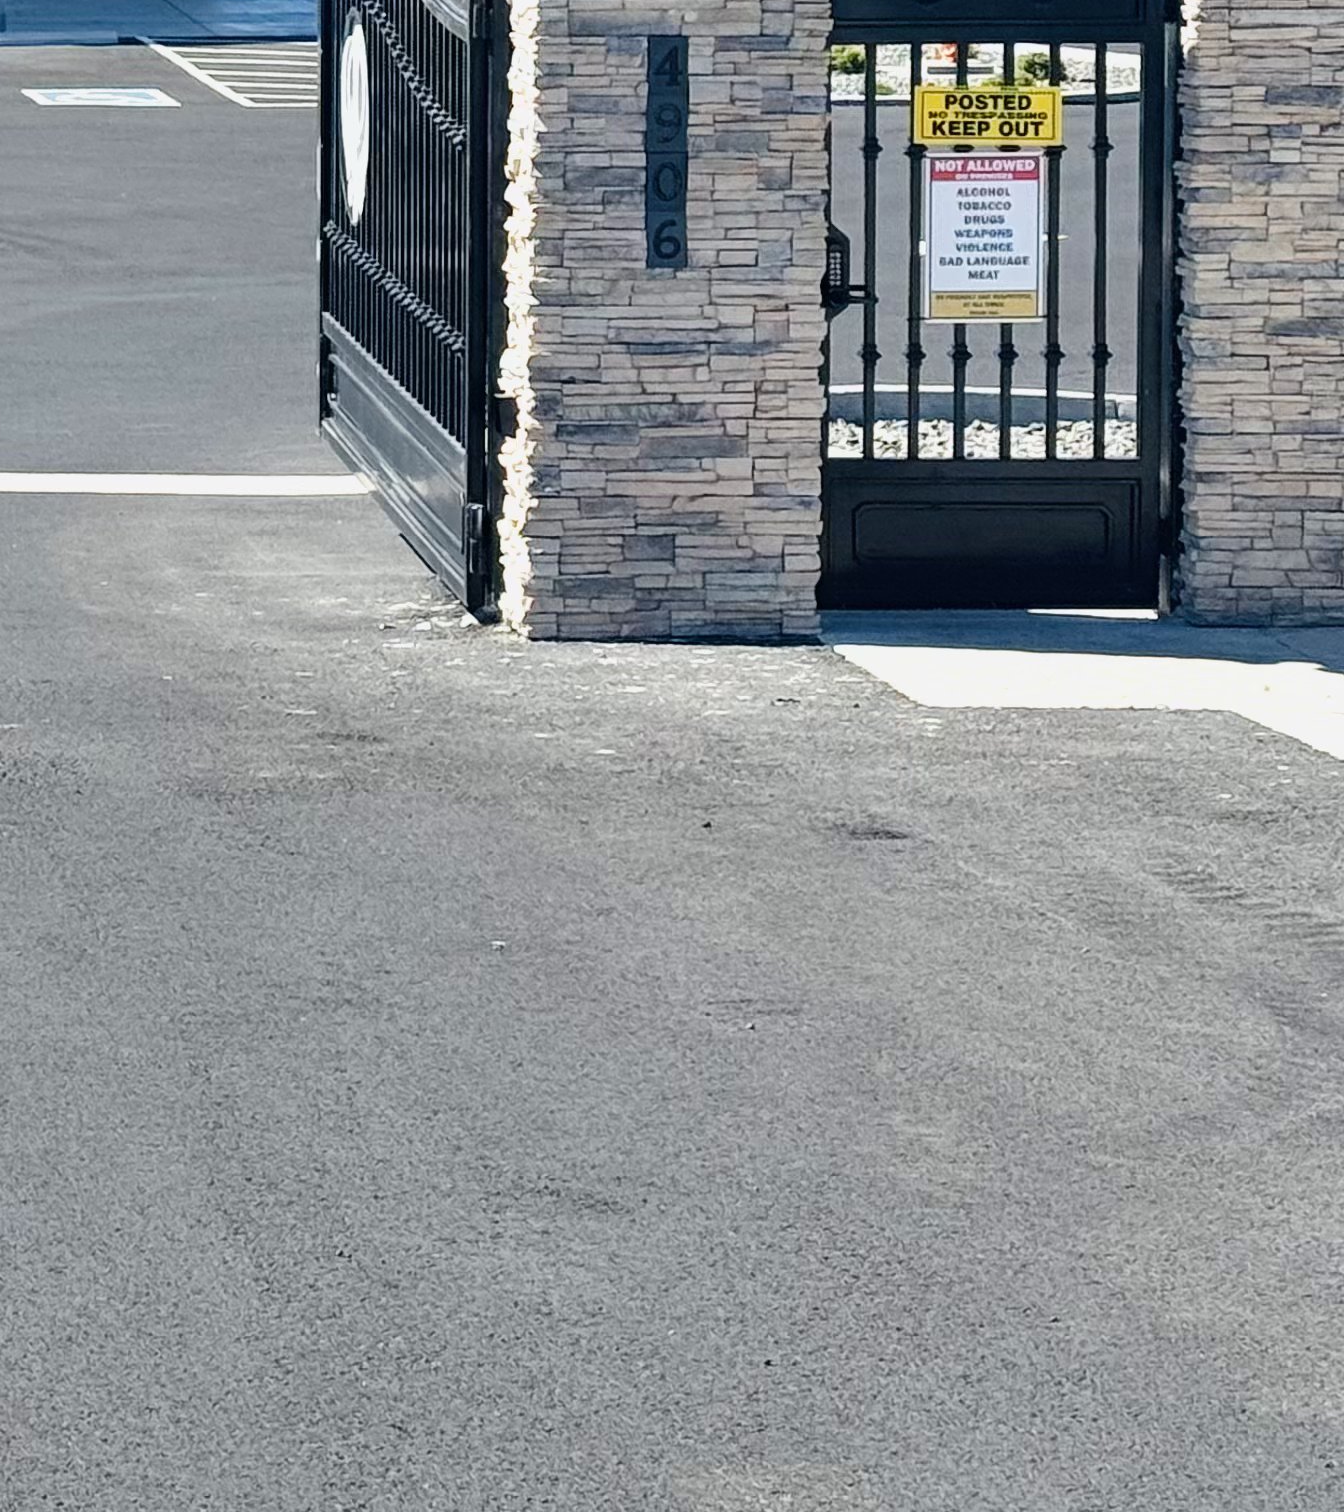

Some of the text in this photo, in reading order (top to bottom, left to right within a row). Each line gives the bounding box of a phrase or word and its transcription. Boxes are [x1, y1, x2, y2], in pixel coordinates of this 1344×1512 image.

[944, 94, 1032, 111] POSTED
[928, 110, 1048, 120] NO TRESPASSING
[931, 120, 1045, 137] KEEP OUT
[652, 45, 683, 260] 4906
[934, 159, 1036, 172] NOT ALLOWED
[956, 187, 1011, 197] ALCOHOL
[957, 201, 1012, 211] TOBACCO
[963, 215, 1006, 225] DRUGS
[954, 228, 1014, 238] WEAPONS
[955, 242, 1014, 253] VIOLENCE
[939, 256, 1030, 266] BAD LANGUAGE
[968, 270, 1000, 280] MEAT
